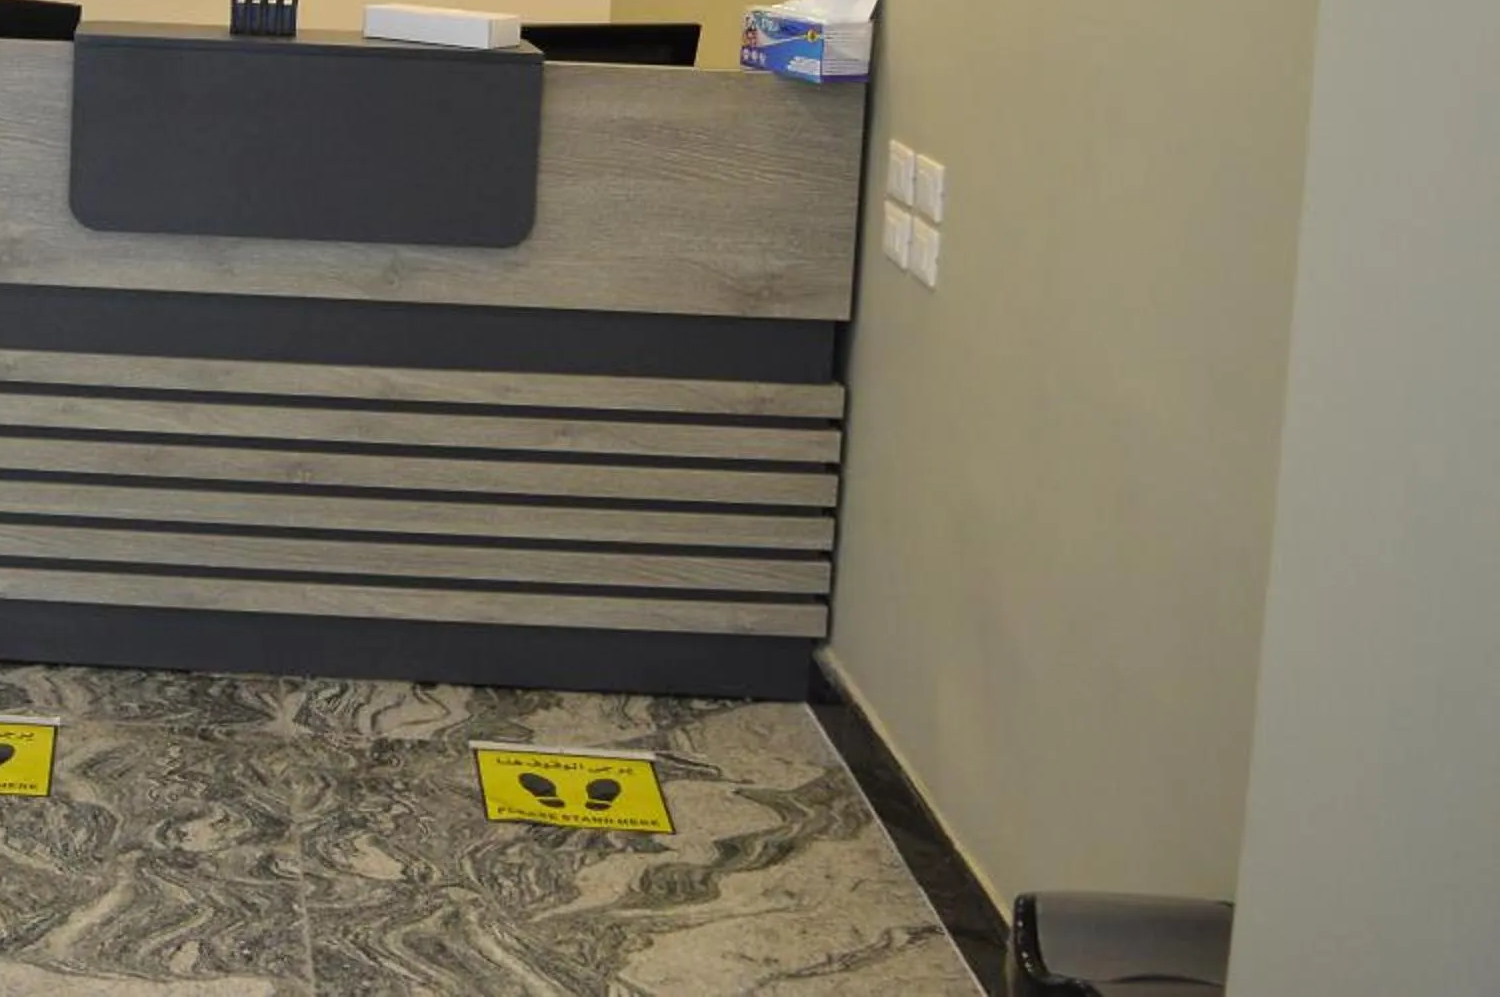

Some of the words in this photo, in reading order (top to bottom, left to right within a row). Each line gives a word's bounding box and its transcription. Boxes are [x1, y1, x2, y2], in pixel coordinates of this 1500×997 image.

[497, 807, 559, 821] PLEASE
[561, 814, 613, 824] STAND
[617, 818, 660, 826] HERE
